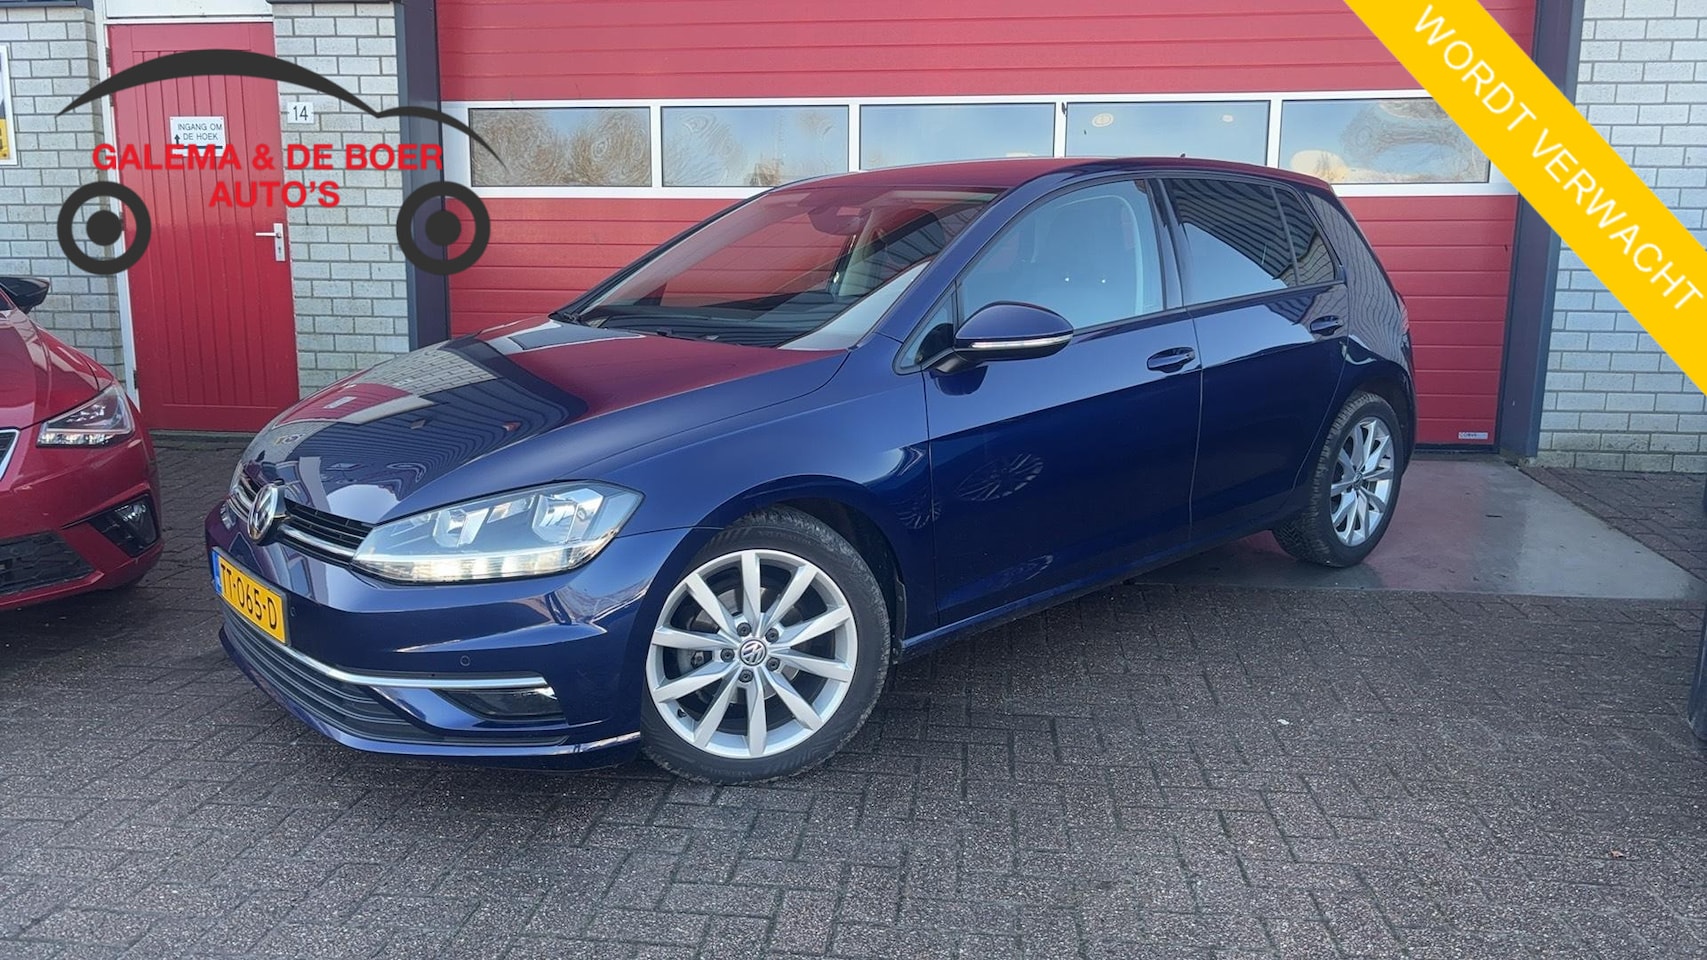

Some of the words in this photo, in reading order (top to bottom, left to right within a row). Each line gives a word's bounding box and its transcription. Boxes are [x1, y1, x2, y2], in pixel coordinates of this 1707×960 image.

[293, 105, 309, 121] 14
[178, 123, 207, 131] INGANG
[209, 123, 223, 131] OM
[182, 132, 194, 141] DE
[196, 132, 219, 141] HOEK
[220, 563, 277, 630] TT-065-D
